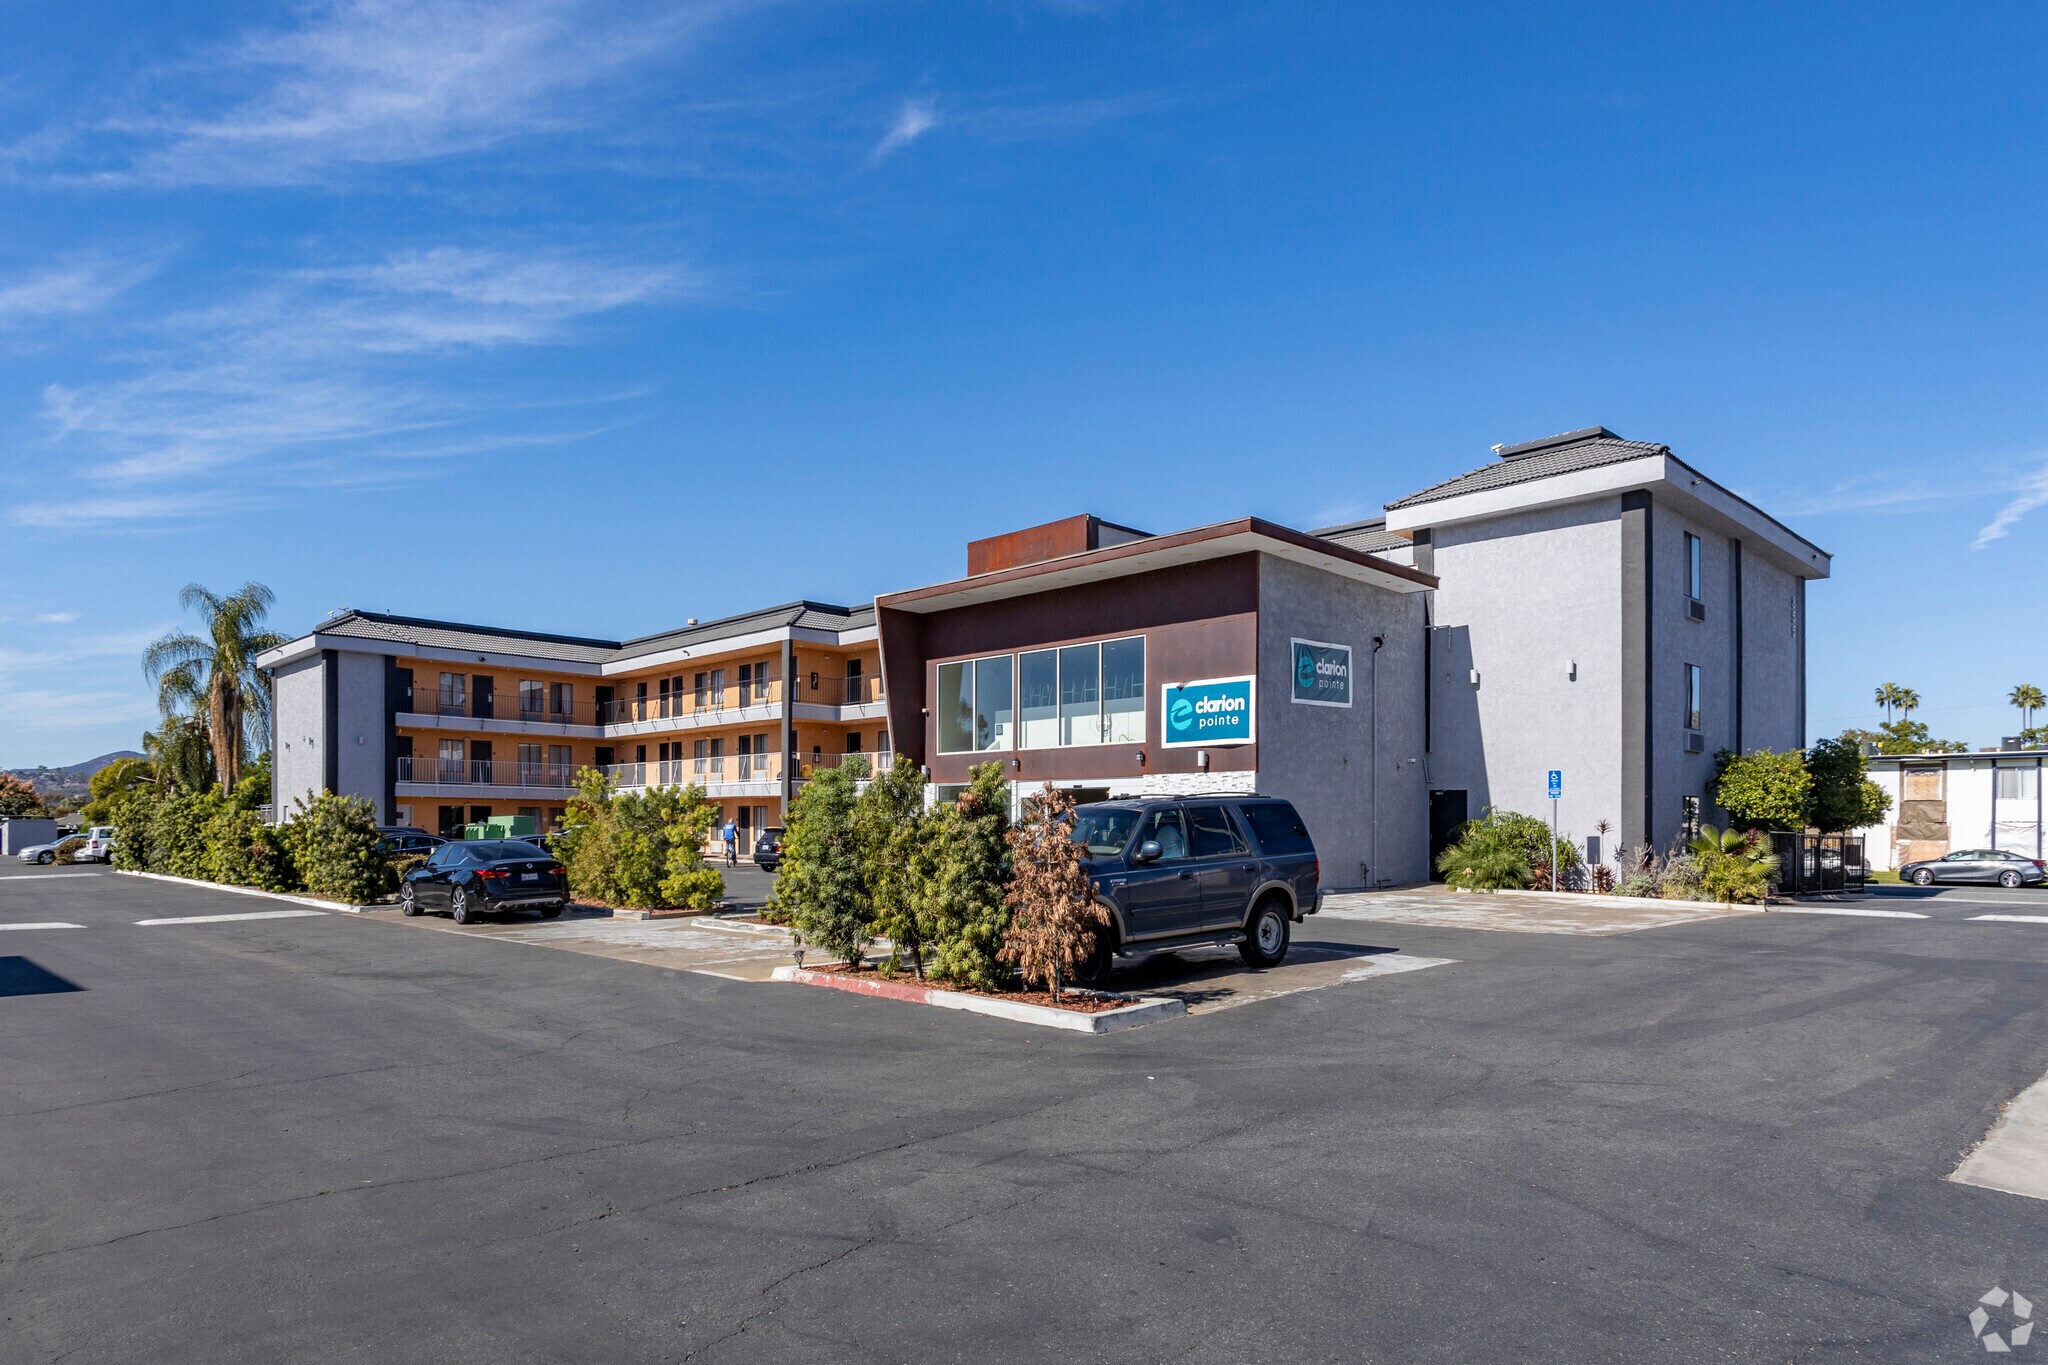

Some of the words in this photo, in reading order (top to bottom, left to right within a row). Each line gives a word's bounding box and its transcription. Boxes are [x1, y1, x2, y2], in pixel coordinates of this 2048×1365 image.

[1316, 658, 1347, 677] clarion
[1319, 678, 1344, 690] pointe
[1195, 694, 1245, 714] clarion
[1199, 715, 1239, 730] pointe
